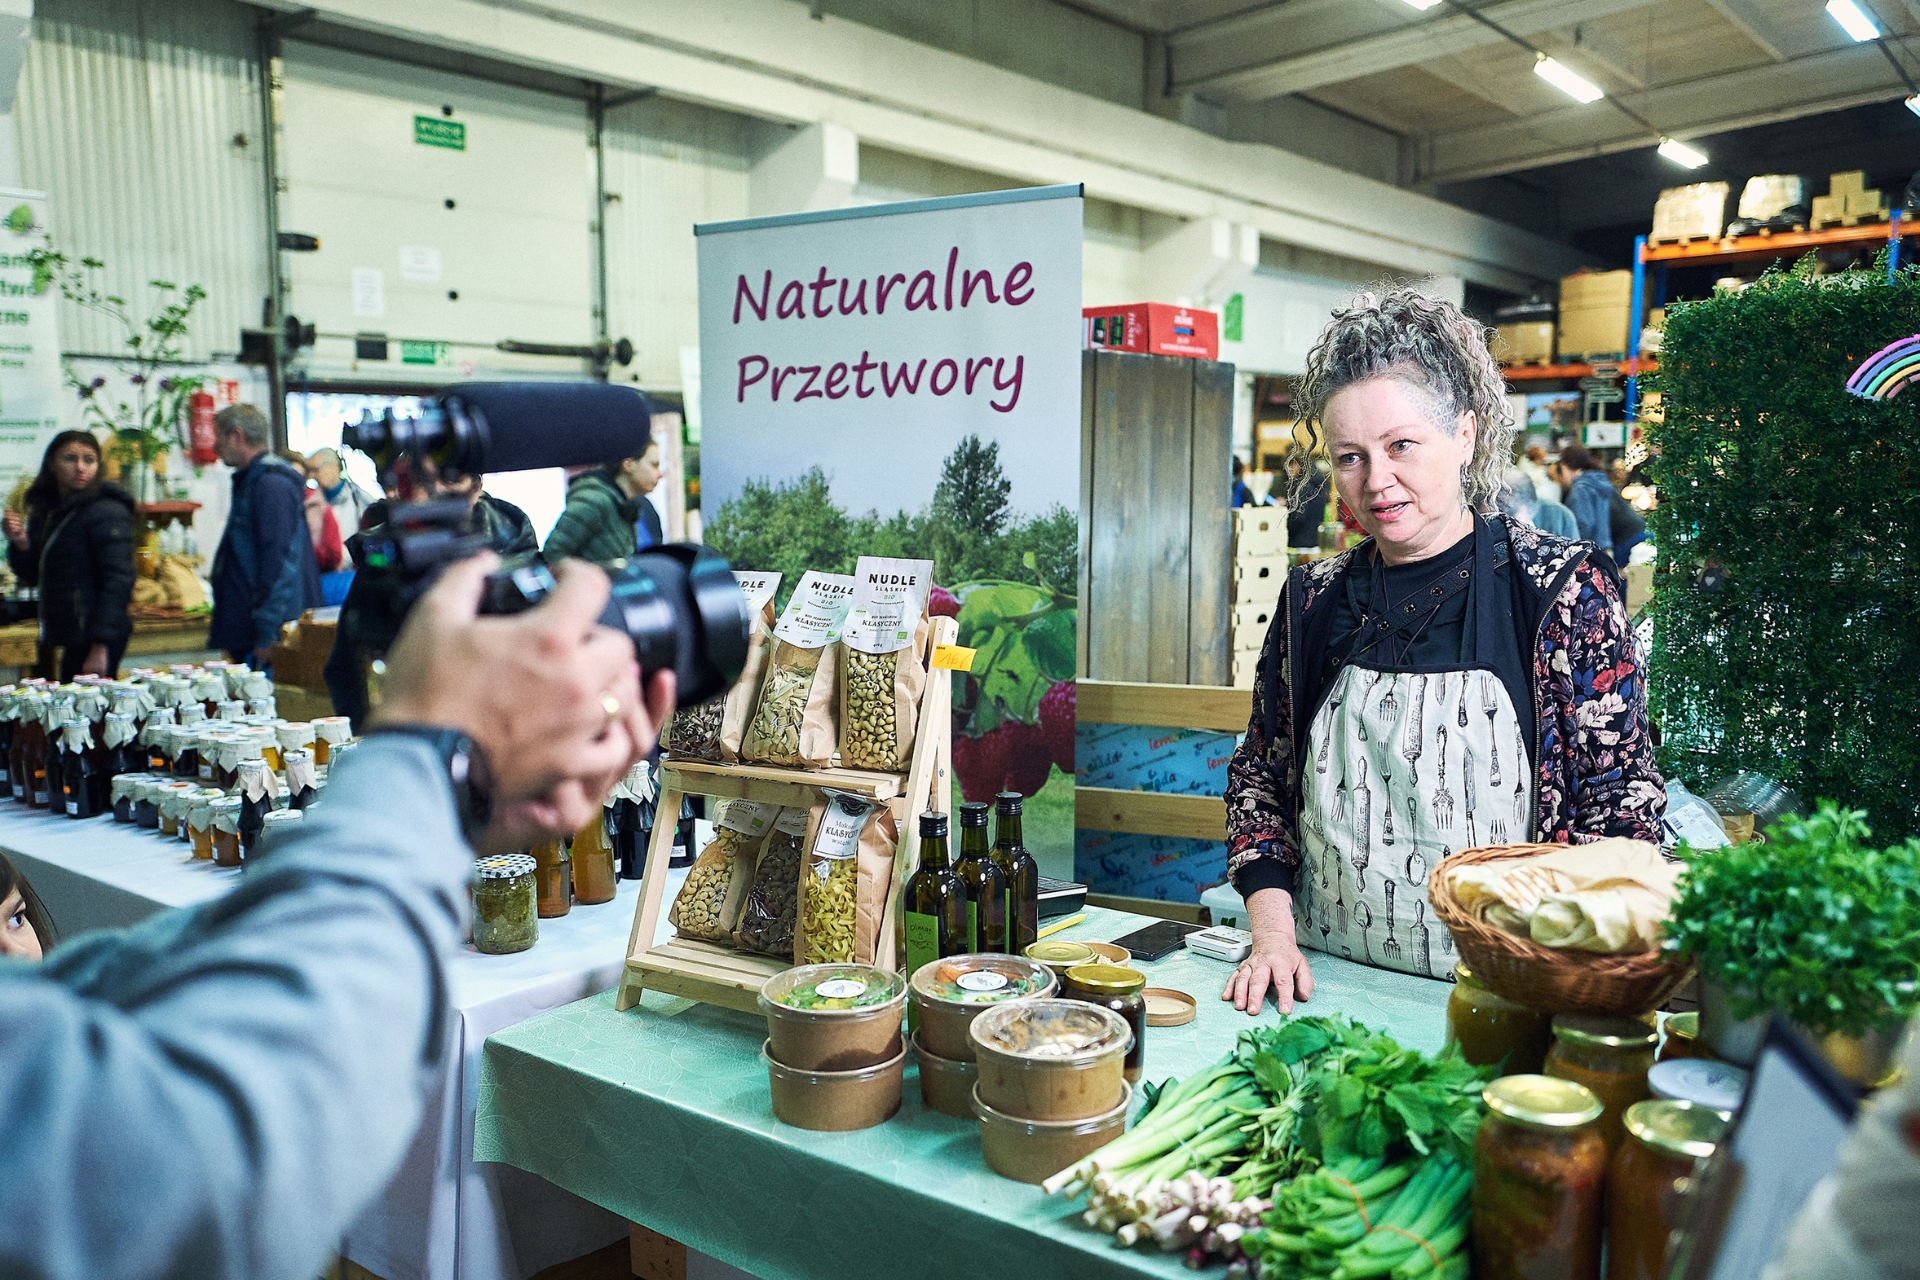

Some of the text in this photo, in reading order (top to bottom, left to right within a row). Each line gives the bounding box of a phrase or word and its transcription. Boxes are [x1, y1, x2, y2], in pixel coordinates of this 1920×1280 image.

[733, 246, 1034, 324] Naturalne
[738, 350, 1024, 412] Przetwory
[738, 580, 766, 589] DLE
[868, 573, 917, 586] NUDLE
[810, 580, 854, 595] NUDLE
[875, 585, 908, 593] ŚLĄSKIE
[794, 616, 835, 628] KLASYCZNY
[862, 619, 902, 627] KLASYCZNY
